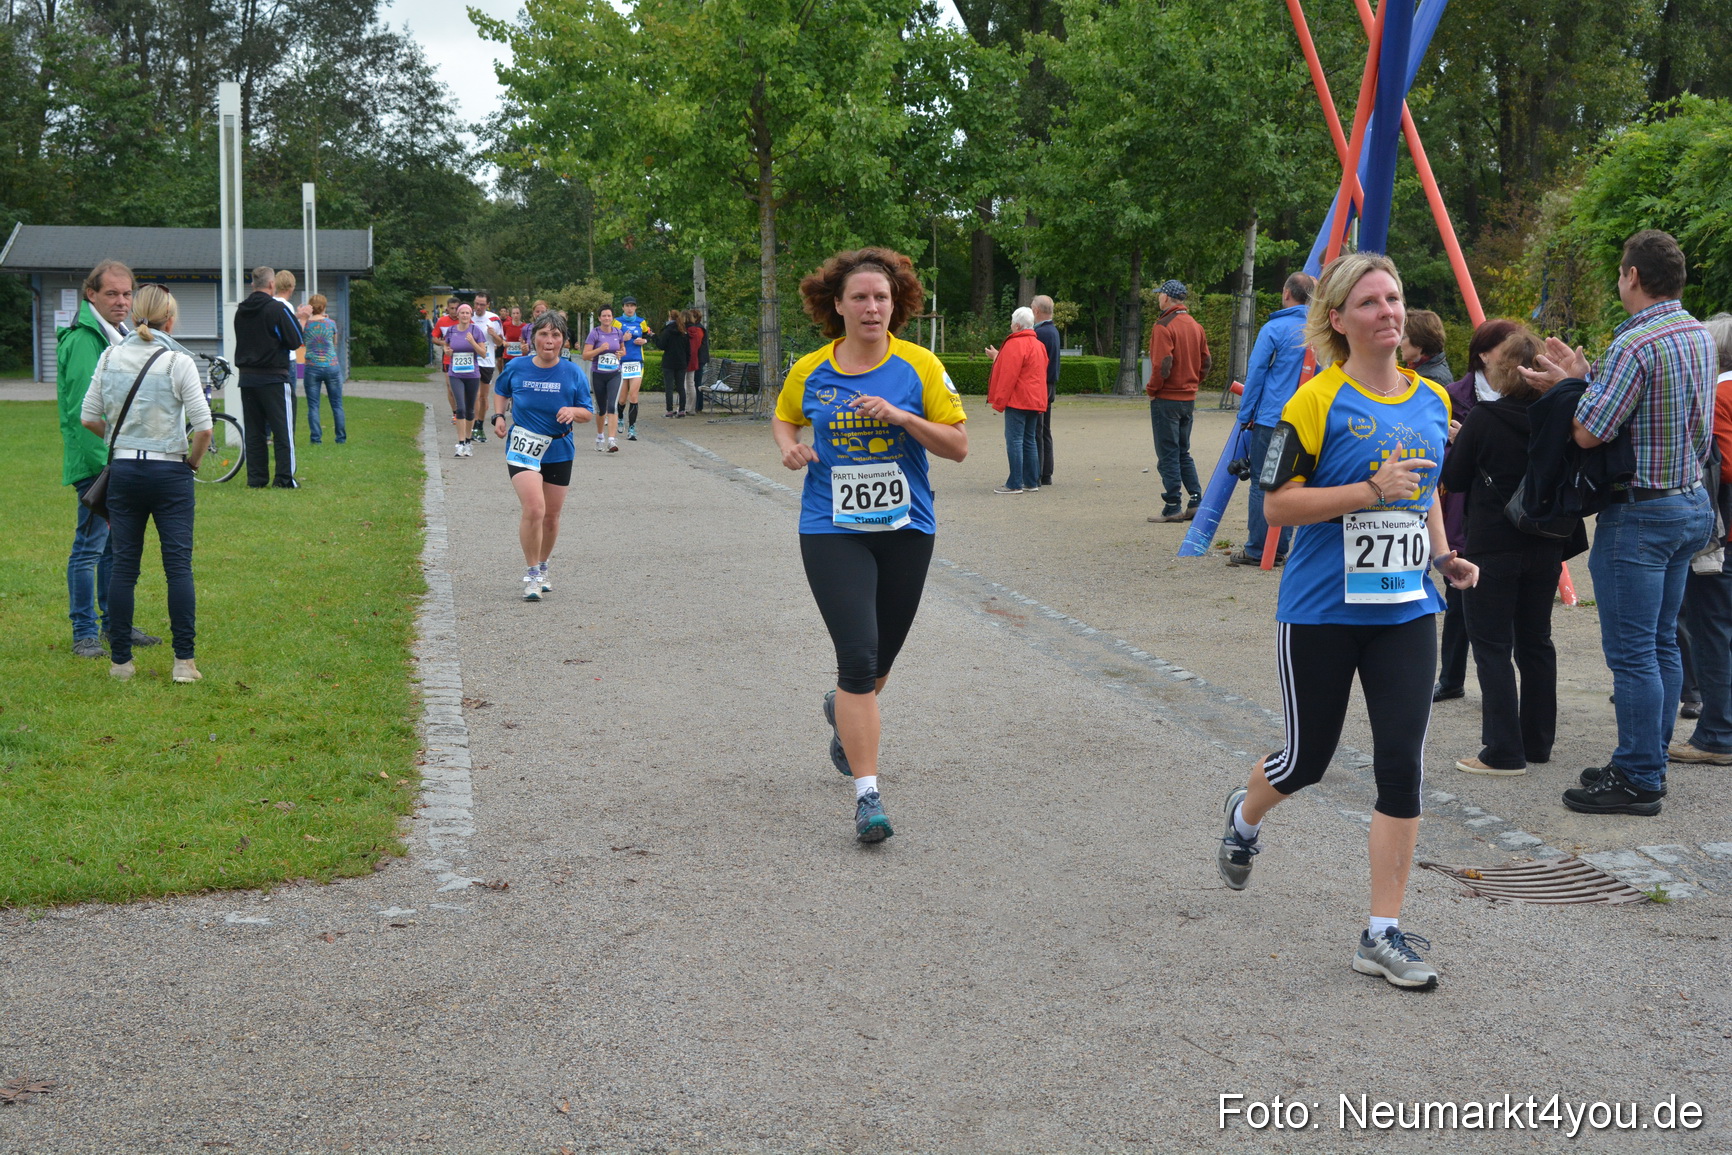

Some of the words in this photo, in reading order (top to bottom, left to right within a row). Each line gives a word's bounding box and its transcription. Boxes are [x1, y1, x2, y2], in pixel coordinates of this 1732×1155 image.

[454, 356, 472, 365] 2233
[512, 436, 544, 457] 2615
[857, 470, 896, 480] Neumarkt
[840, 479, 904, 511] 2629
[1346, 521, 1380, 531] PARTL
[1355, 533, 1425, 568] 2710
[1381, 576, 1405, 590] Silke
